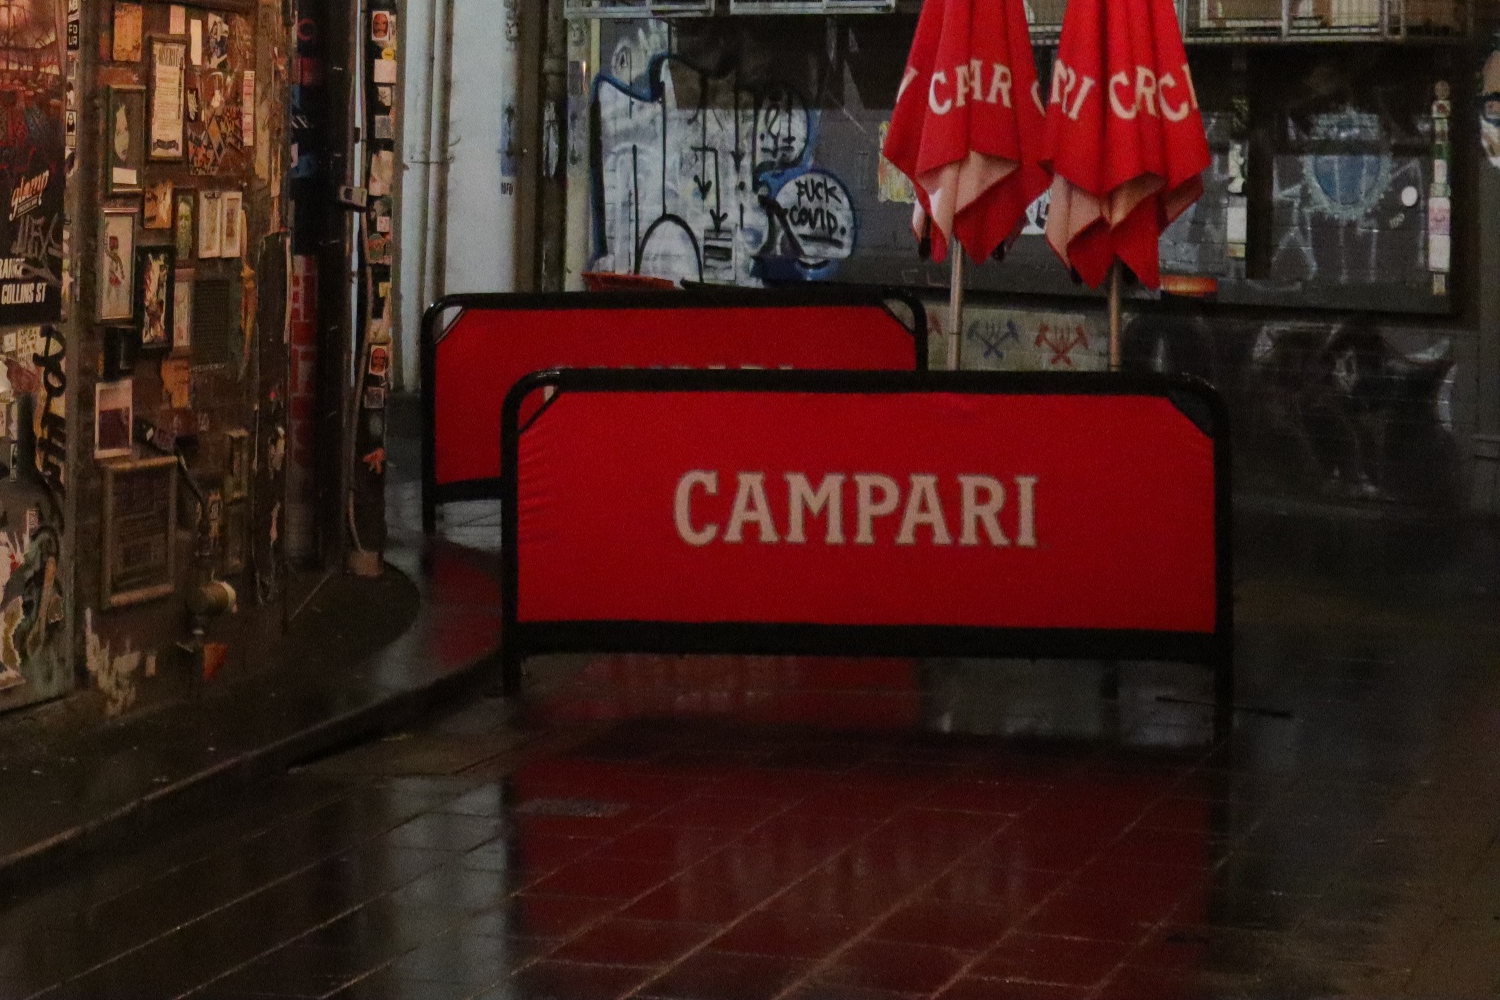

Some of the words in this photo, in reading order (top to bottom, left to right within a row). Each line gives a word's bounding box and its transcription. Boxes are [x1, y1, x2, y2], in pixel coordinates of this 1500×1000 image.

[794, 177, 842, 208] FUCK
[1, 282, 35, 304] COLLINS
[36, 281, 48, 303] ST
[673, 468, 1039, 547] CAMPARI
